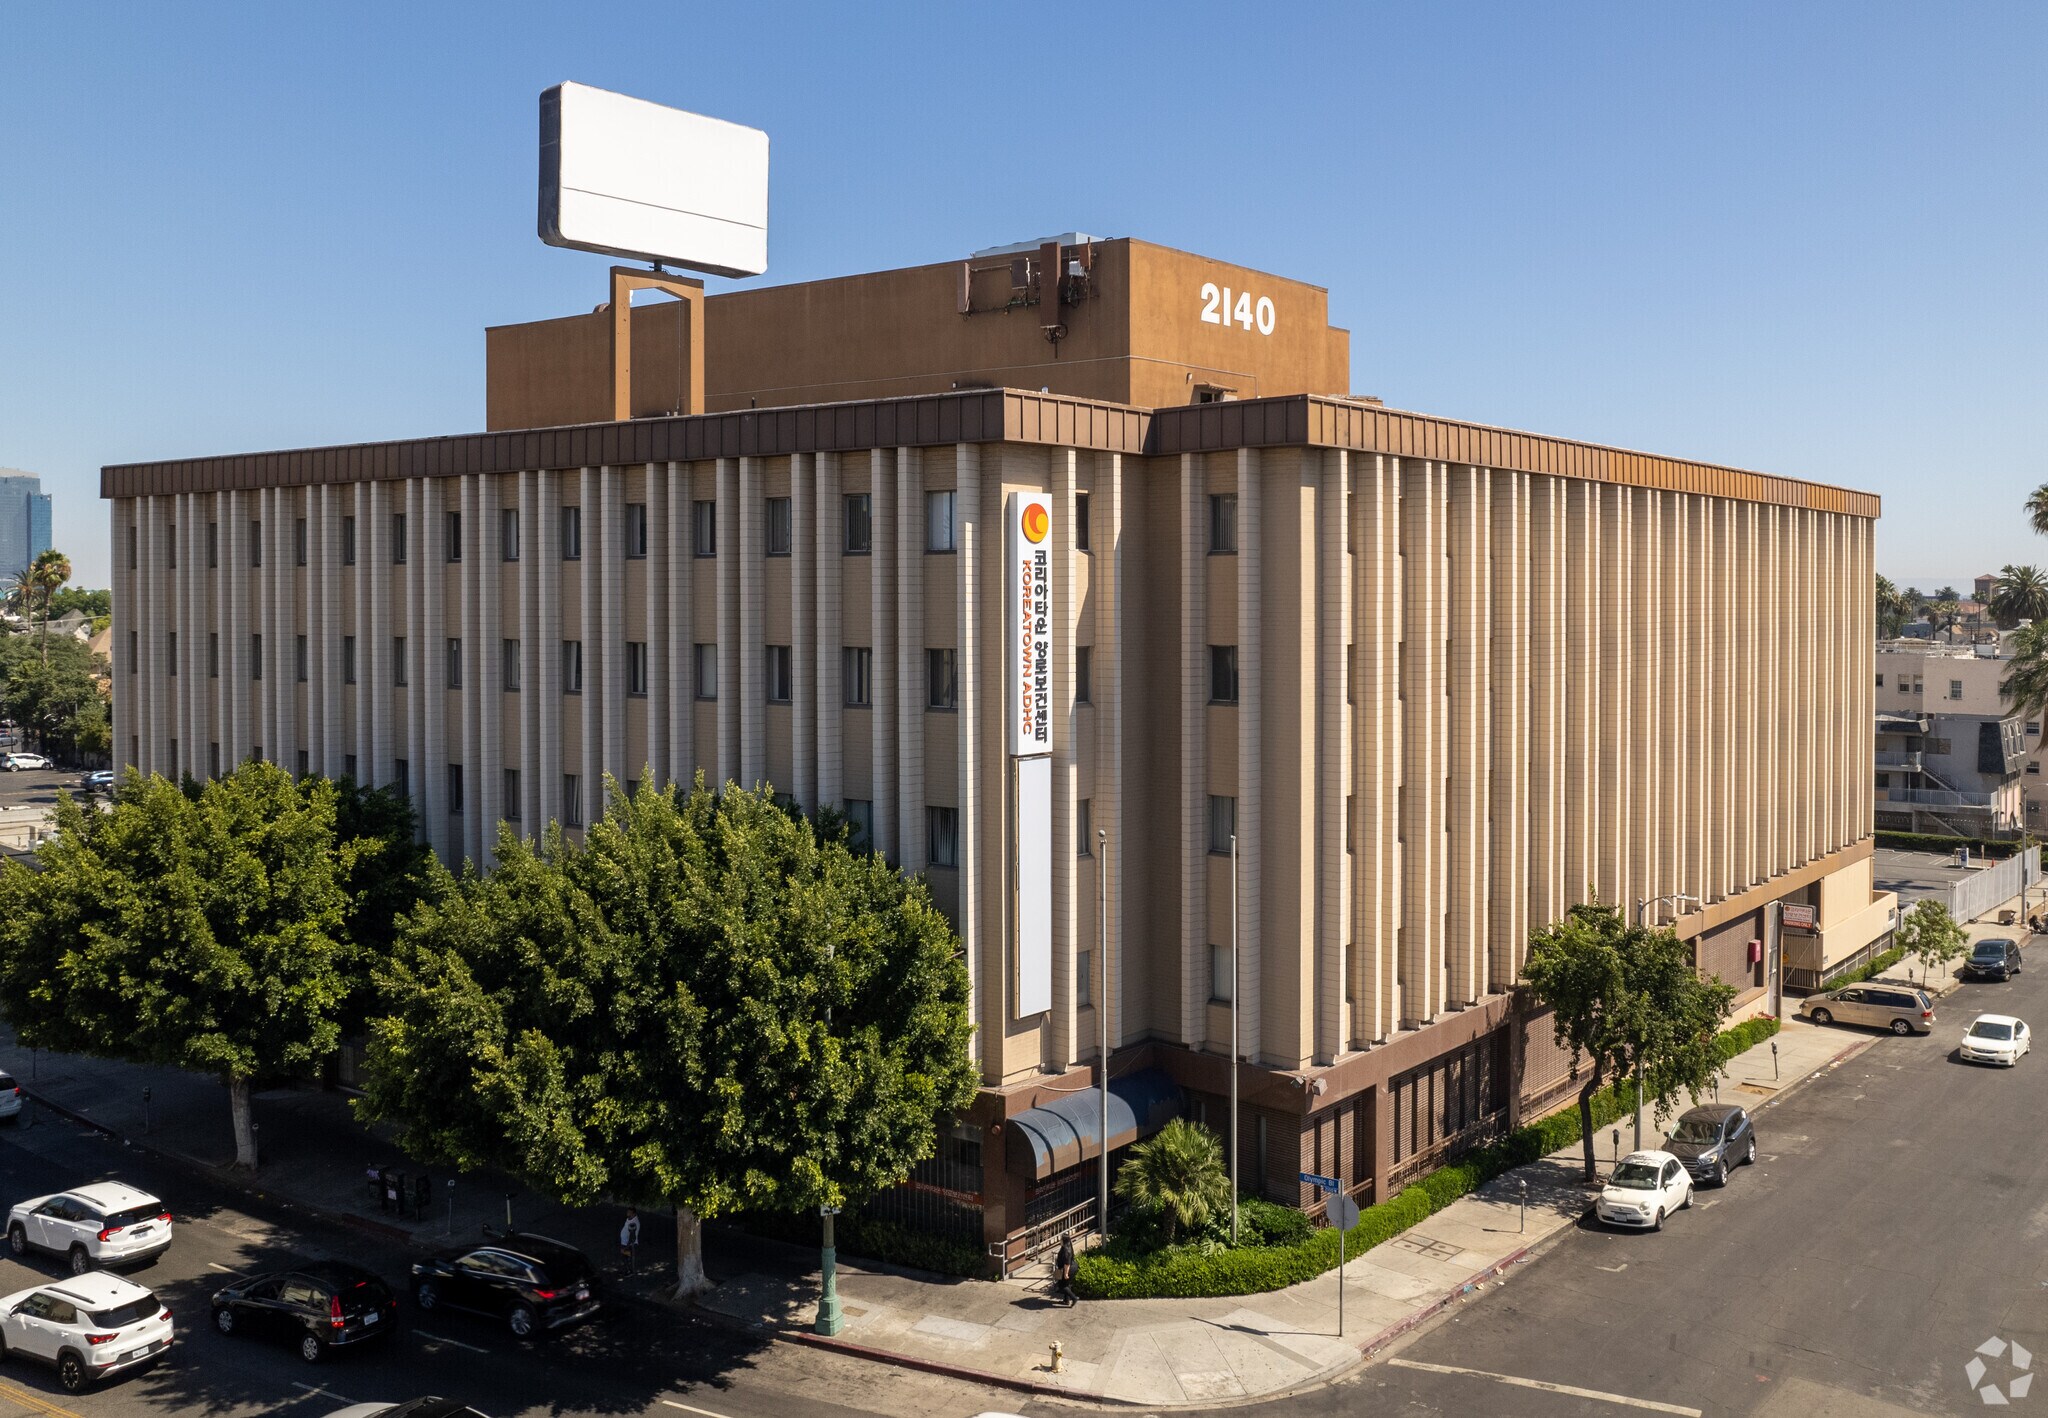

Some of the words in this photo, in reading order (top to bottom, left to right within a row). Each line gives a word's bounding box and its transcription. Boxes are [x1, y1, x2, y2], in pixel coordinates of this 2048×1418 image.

[1201, 282, 1276, 336] 2140
[1022, 560, 1032, 677] KOREATOWN
[1034, 549, 1049, 635] 코리아타운
[1022, 681, 1032, 735] ADHC
[1034, 641, 1049, 743] 양로보건센터
[1303, 1174, 1327, 1185] Olympic
